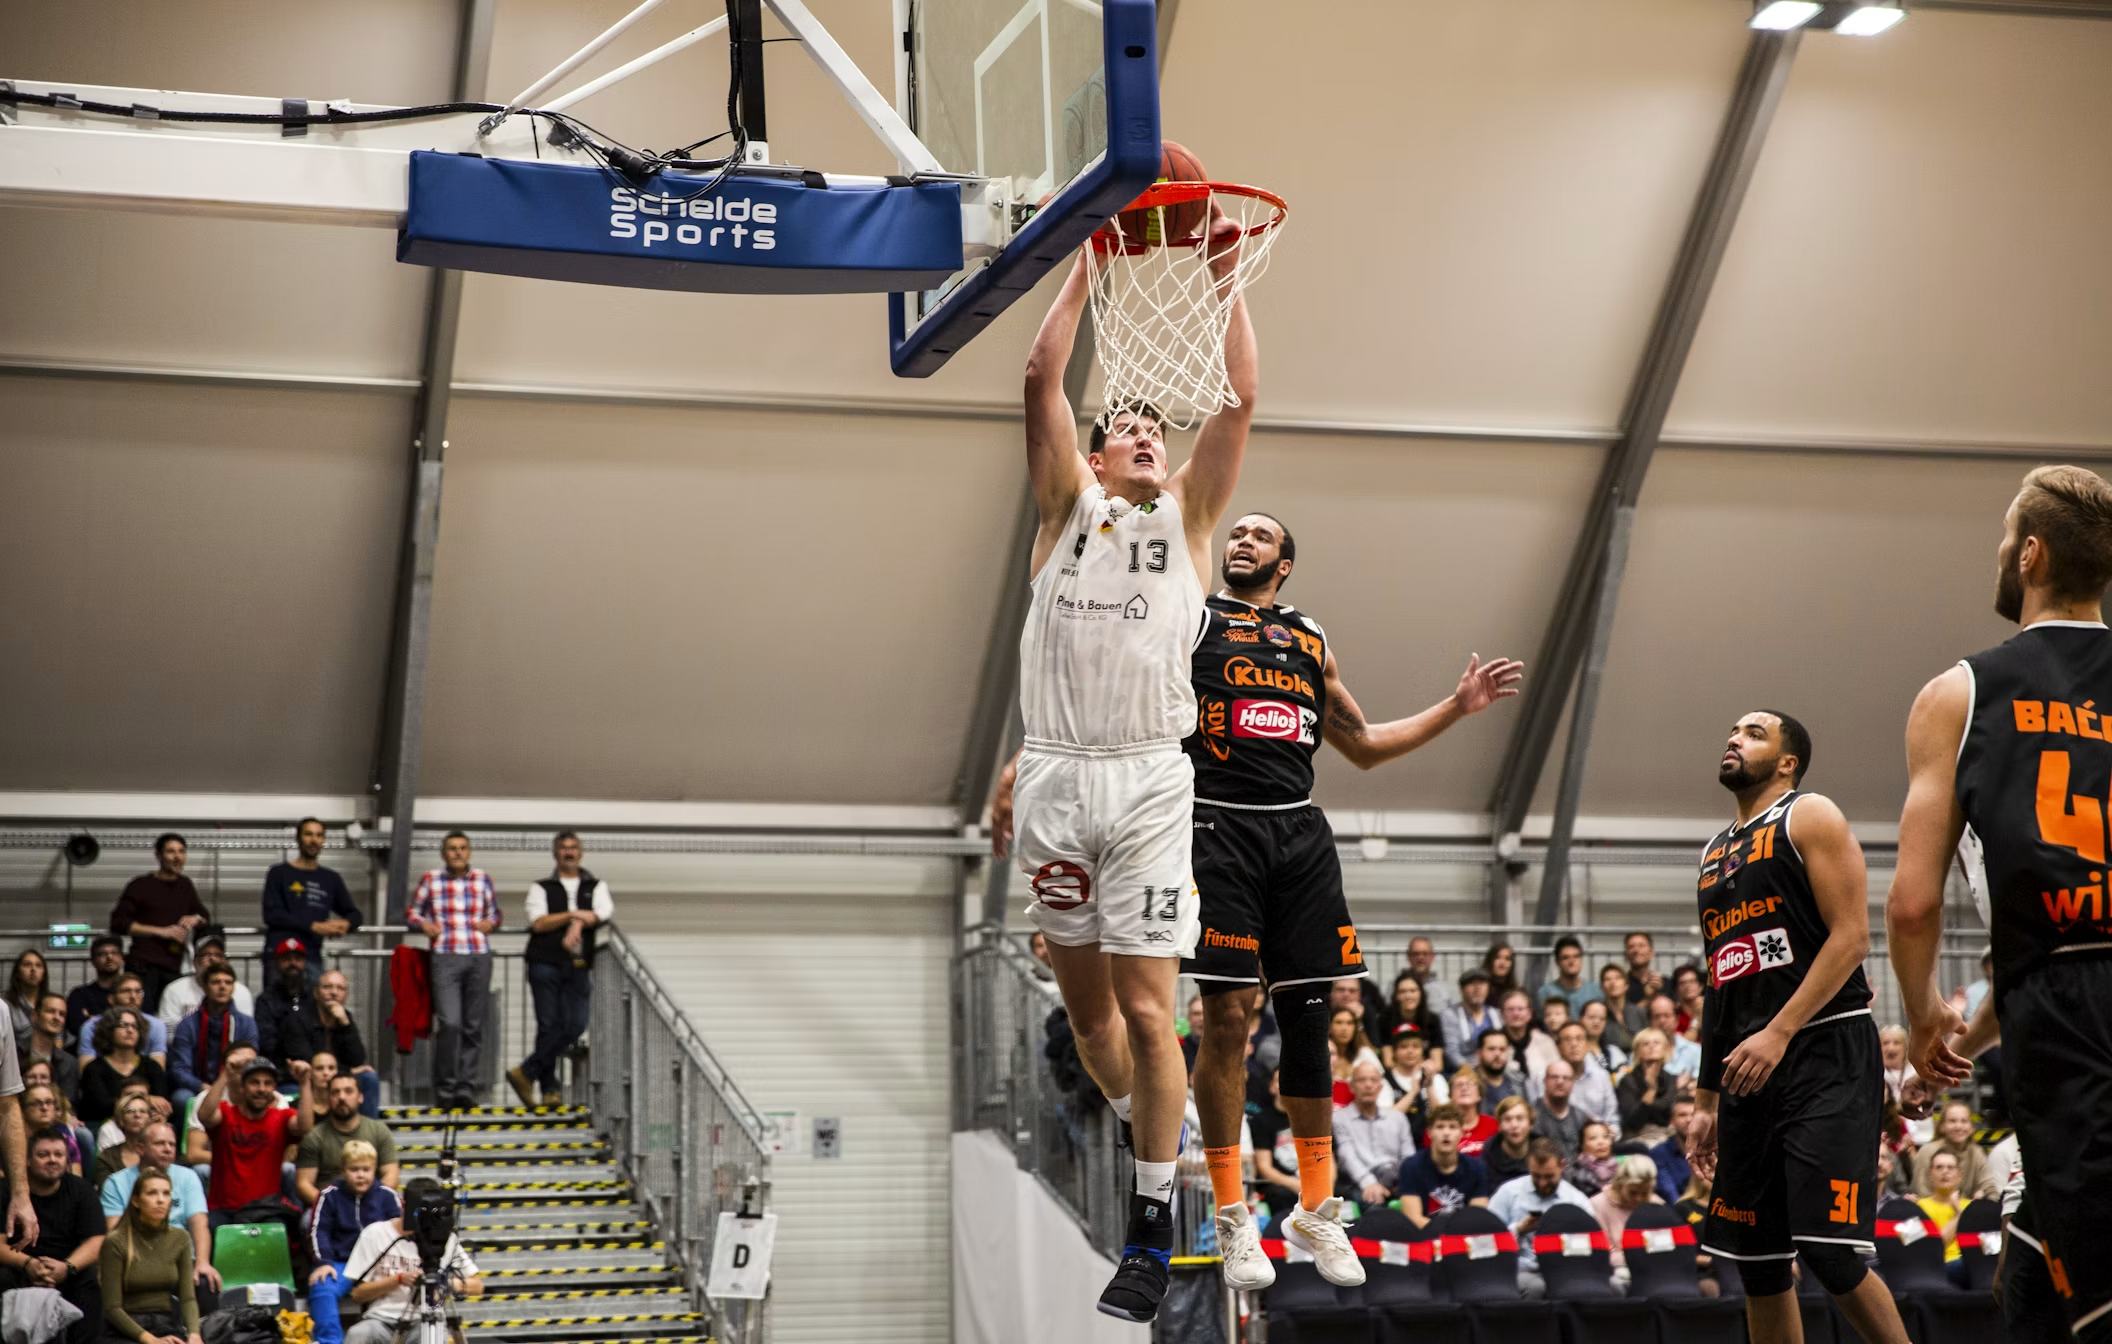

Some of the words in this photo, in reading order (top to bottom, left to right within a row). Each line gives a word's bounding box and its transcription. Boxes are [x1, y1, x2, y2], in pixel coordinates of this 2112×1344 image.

[611, 187, 777, 224] Schelde
[610, 213, 776, 250] Sports
[1128, 539, 1169, 574] 13
[1077, 600, 1085, 610] &
[1087, 600, 1122, 610] Bauen
[1207, 700, 1226, 738] SDV
[1239, 709, 1297, 730] Helios
[2034, 750, 2112, 865] 4
[1746, 824, 1777, 865] 31
[1141, 885, 1180, 922] 13
[1337, 925, 1363, 966] 2
[1828, 1179, 1859, 1225] 31
[733, 1244, 750, 1268] D
